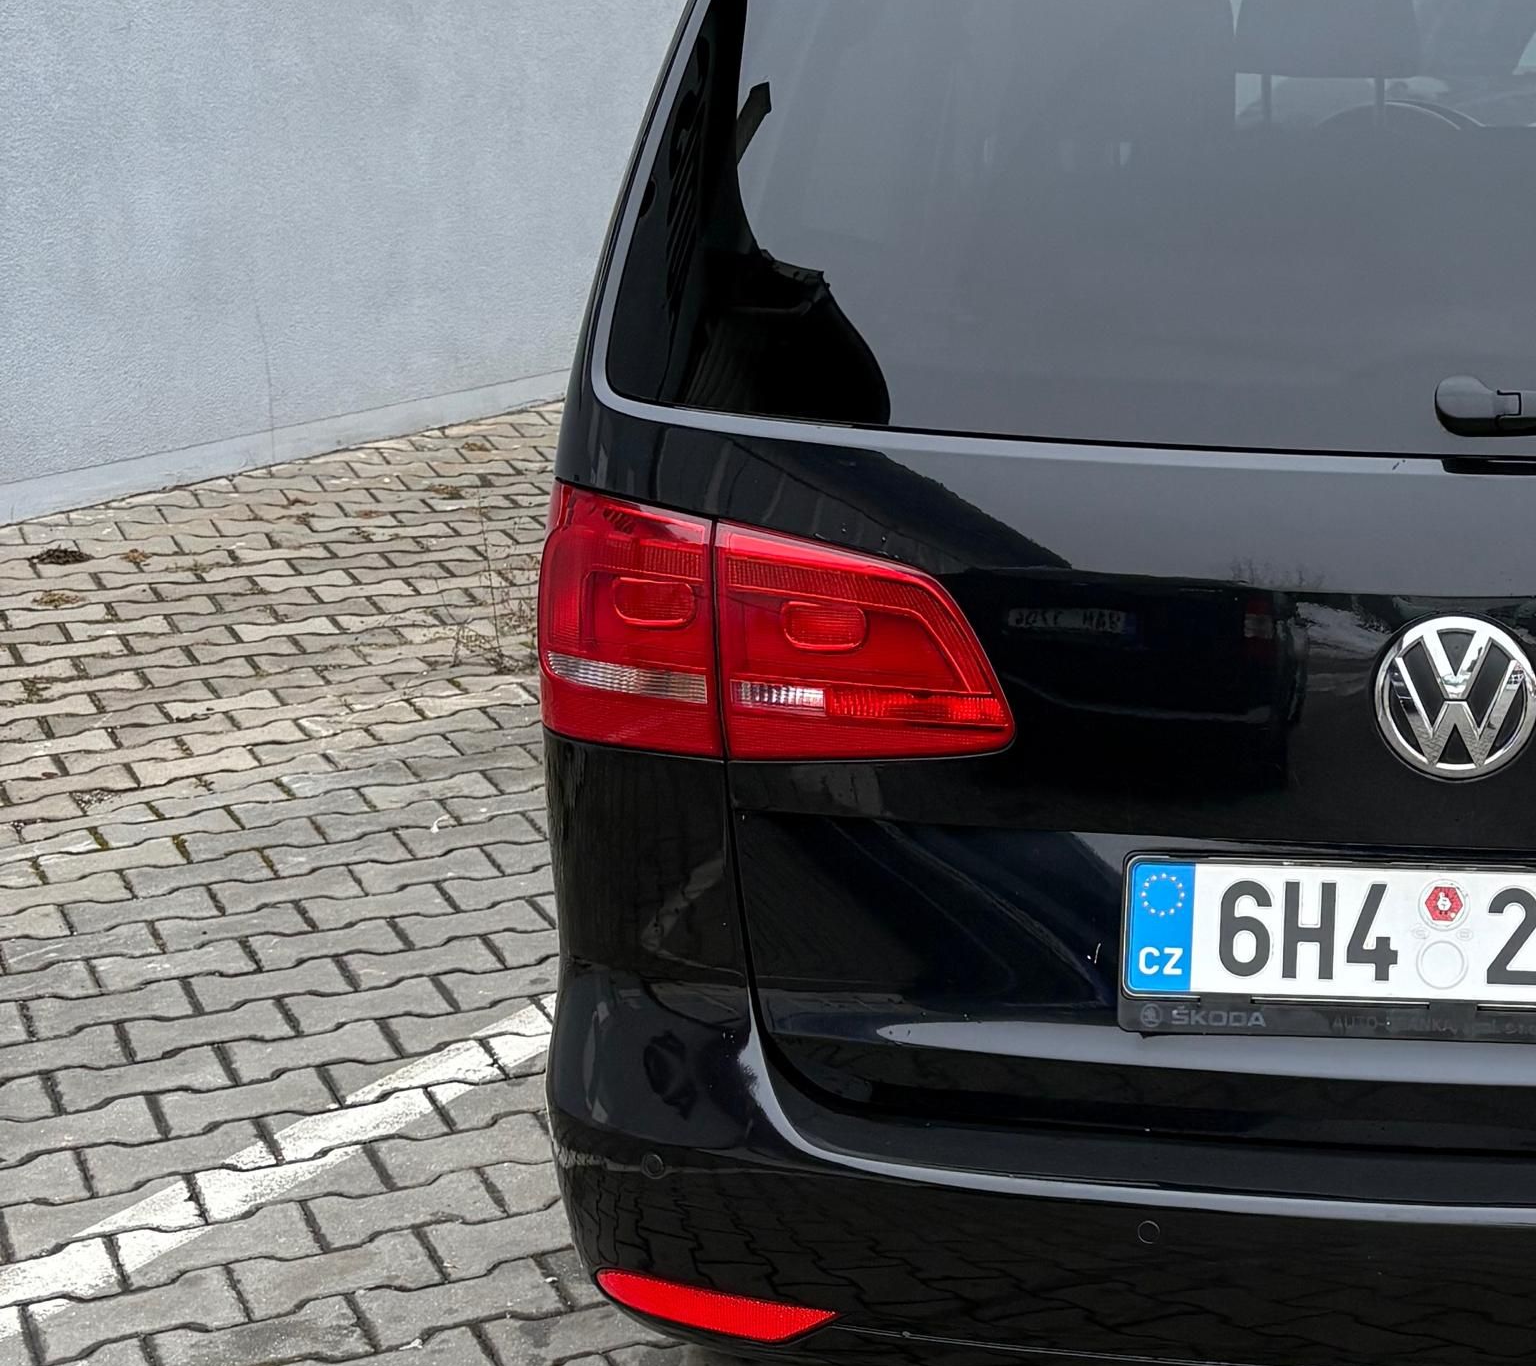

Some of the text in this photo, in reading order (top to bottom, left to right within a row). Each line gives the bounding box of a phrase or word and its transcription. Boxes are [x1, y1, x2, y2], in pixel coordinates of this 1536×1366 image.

[1216, 879, 1399, 983] 6H4
[1138, 946, 1183, 977] CZ
[1171, 1005, 1267, 1027] ŠKODA
